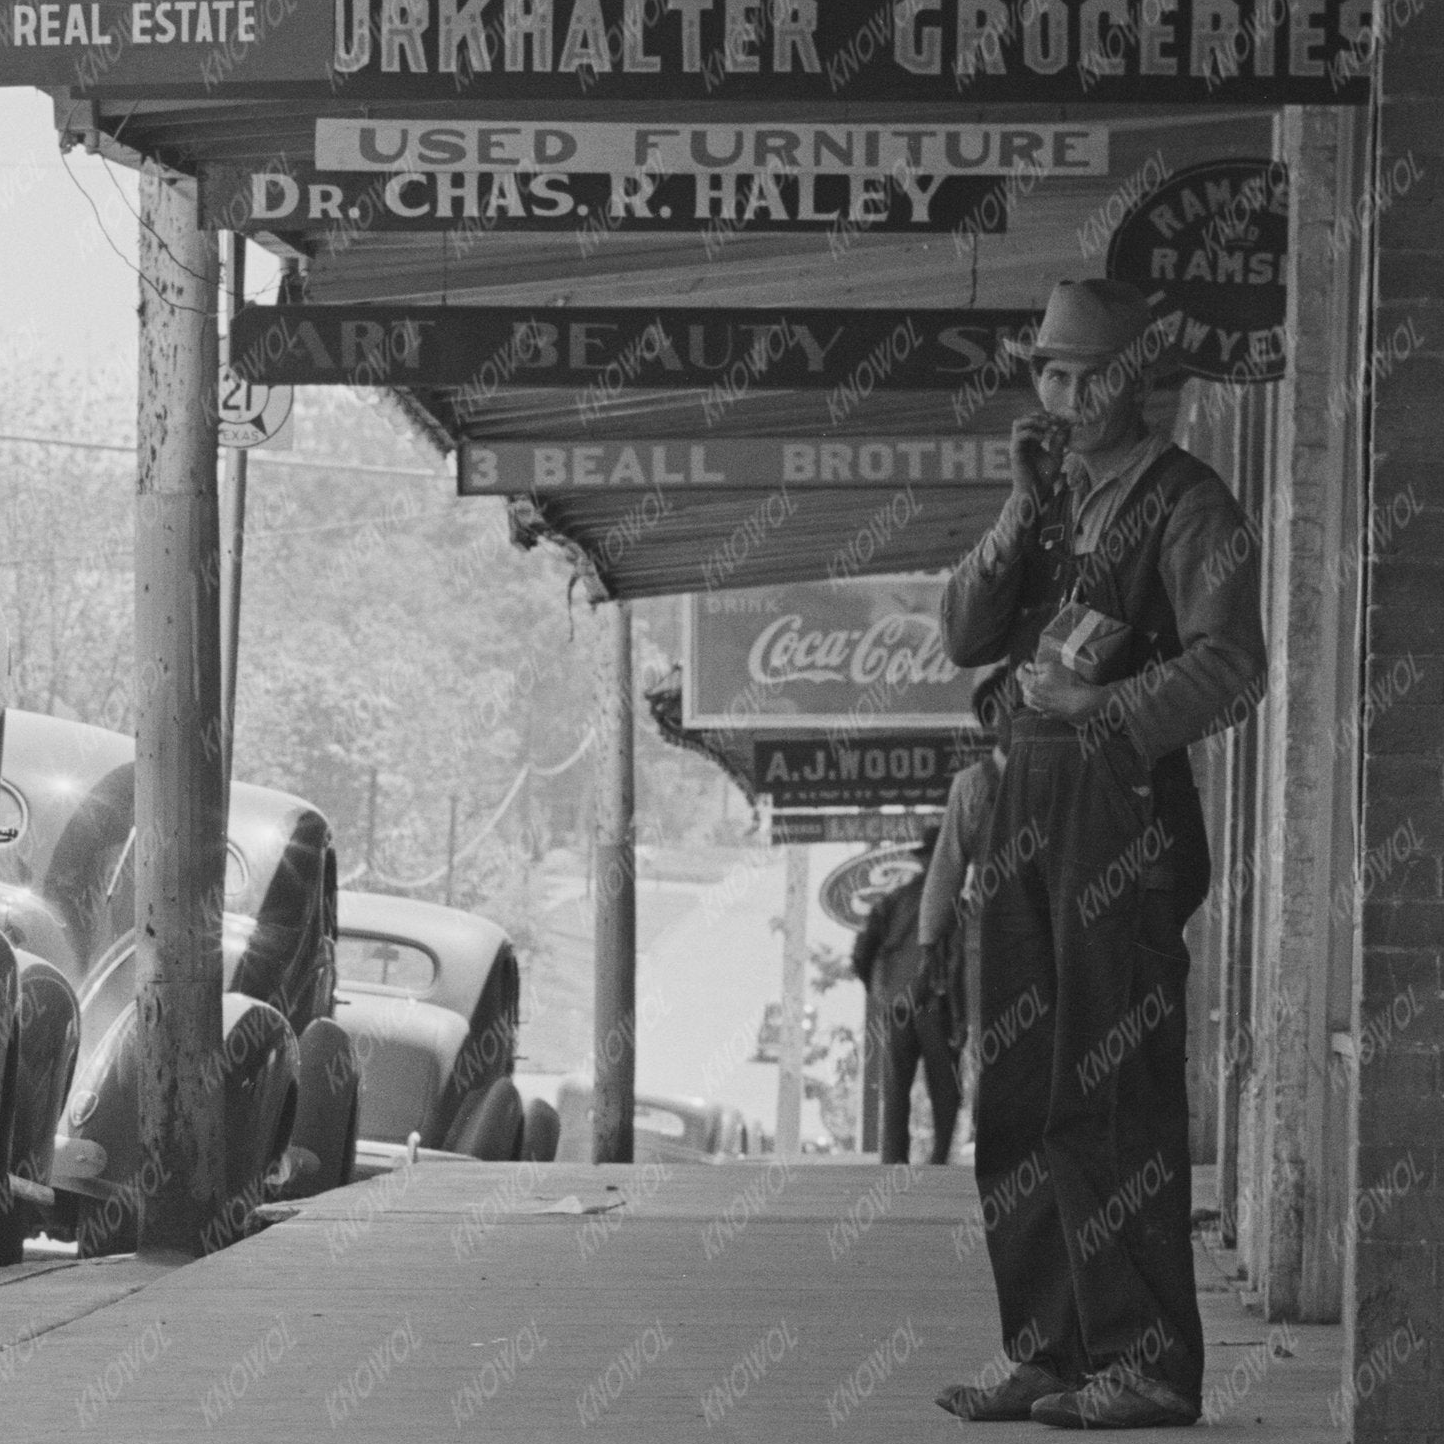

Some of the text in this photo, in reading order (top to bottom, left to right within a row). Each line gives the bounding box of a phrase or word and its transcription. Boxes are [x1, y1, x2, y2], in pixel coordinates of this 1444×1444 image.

[13, 0, 256, 47] REAL ESTATE
[357, 126, 1092, 169] USED FURNITURE
[384, 172, 589, 218] CHAS.
[609, 173, 672, 220] R.
[693, 173, 950, 223] HALEY
[470, 446, 499, 487] 3
[532, 445, 726, 487] BEALL
[748, 614, 958, 684] Coca-Cola
